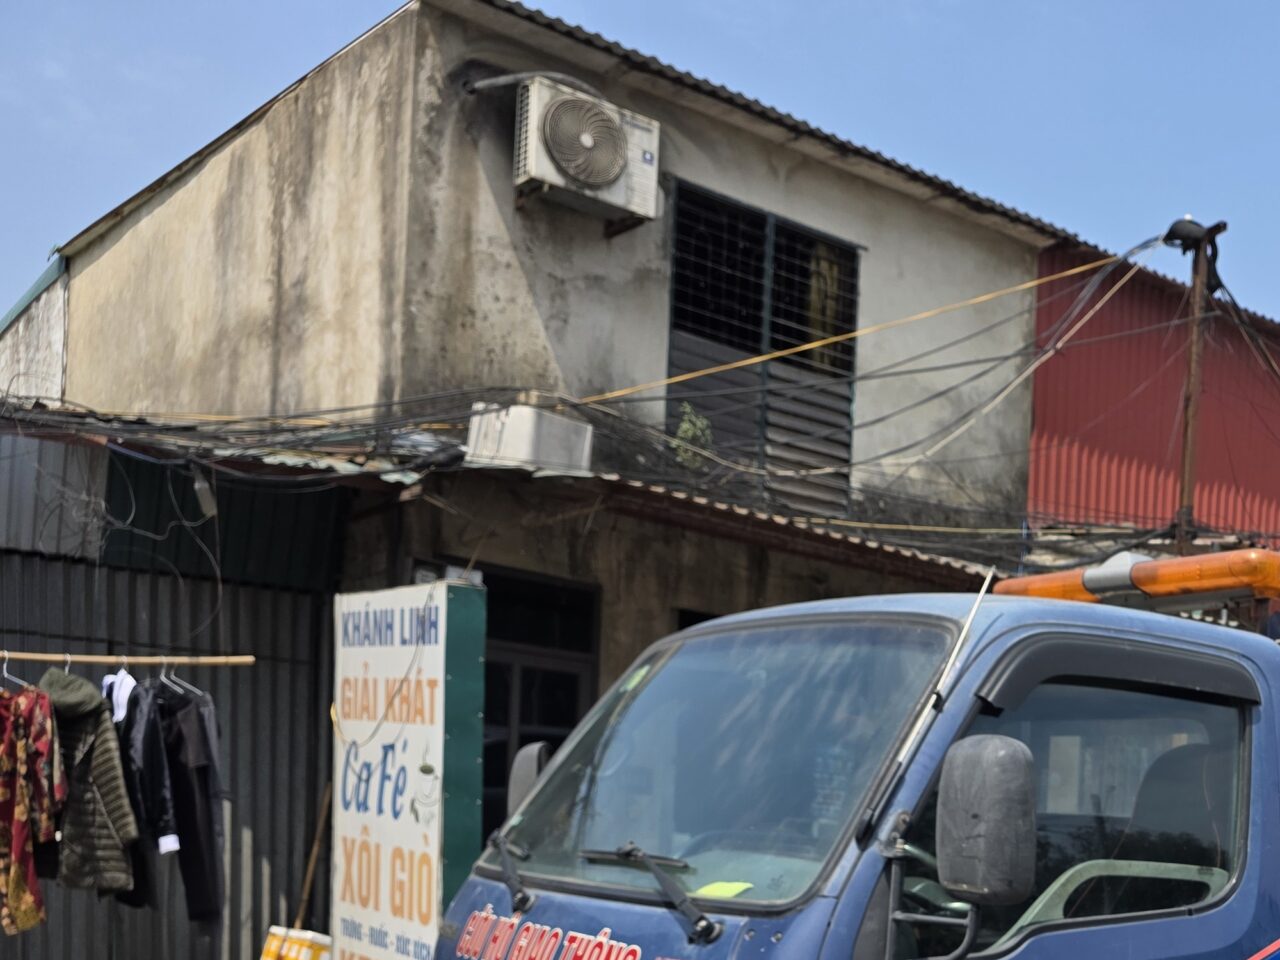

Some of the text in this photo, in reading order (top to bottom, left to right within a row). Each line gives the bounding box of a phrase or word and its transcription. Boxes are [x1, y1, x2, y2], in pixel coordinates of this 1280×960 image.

[342, 601, 438, 647] KHÁNH LINH
[341, 825, 432, 926] XÔI GIÒ
